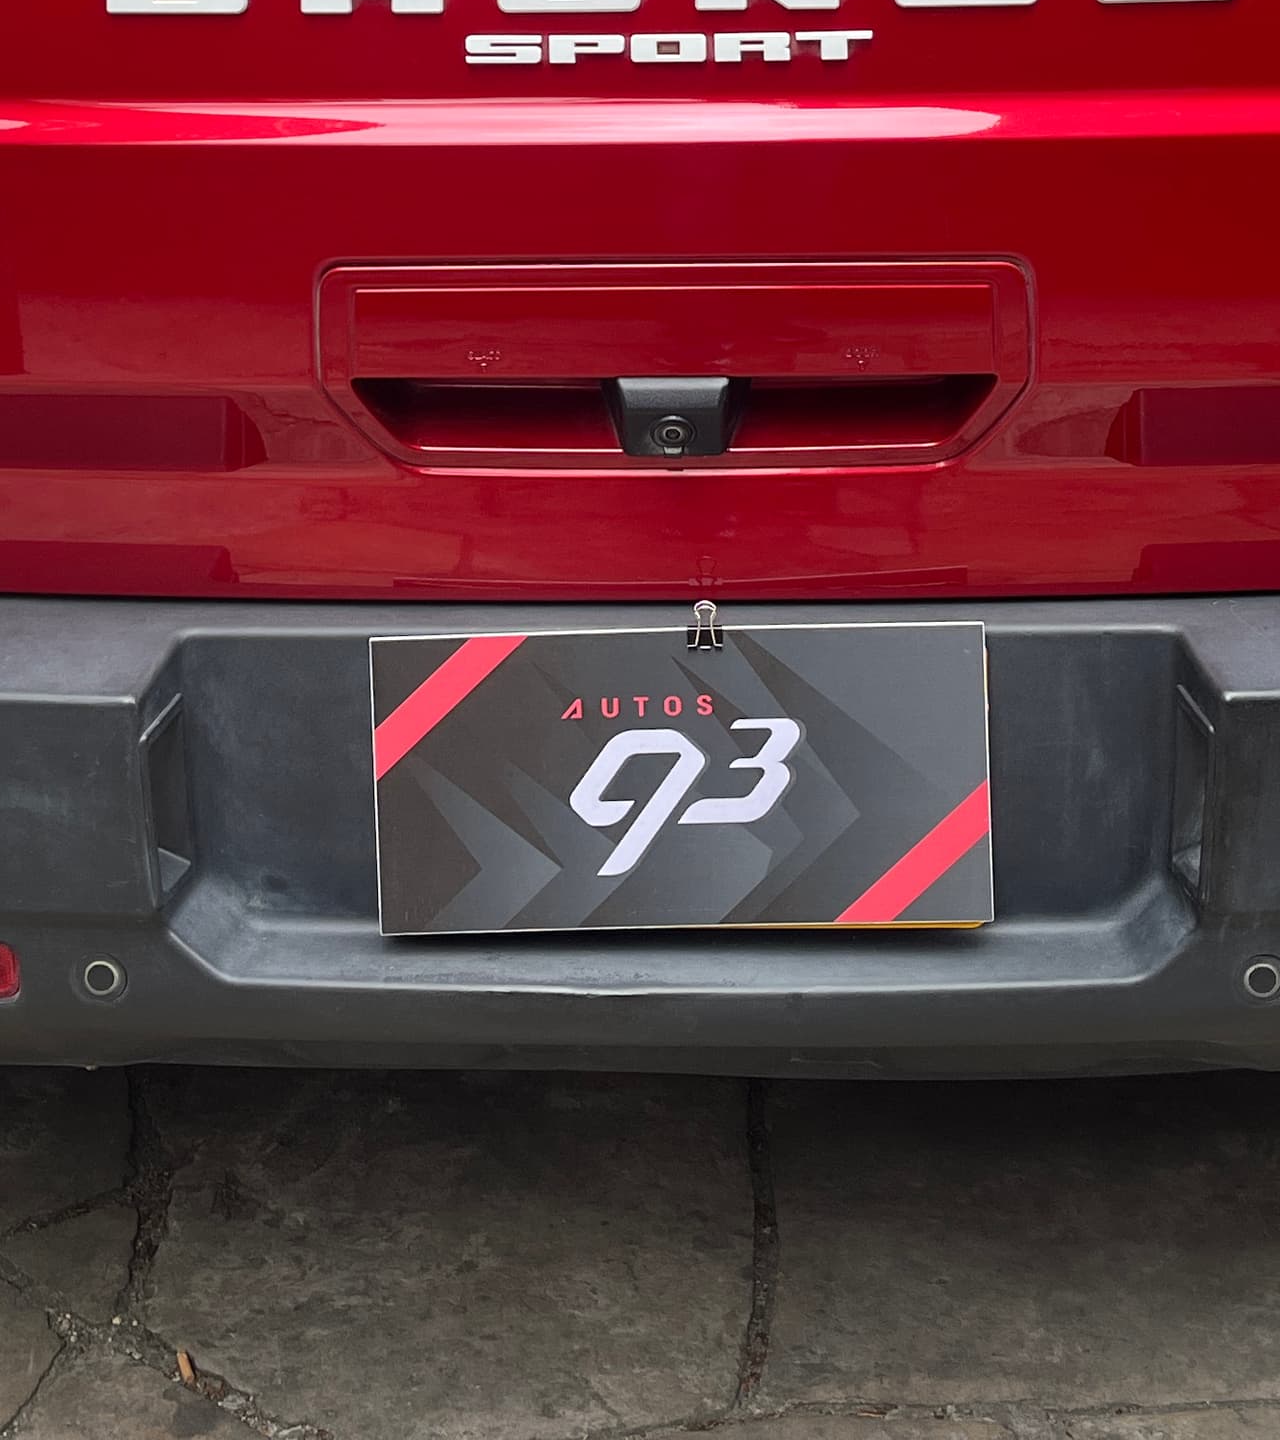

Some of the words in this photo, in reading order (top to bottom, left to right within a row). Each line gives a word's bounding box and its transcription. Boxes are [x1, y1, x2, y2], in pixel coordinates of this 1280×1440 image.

[464, 29, 874, 65] SPORT
[561, 694, 715, 720] AUTOS
[569, 717, 802, 877] 93
